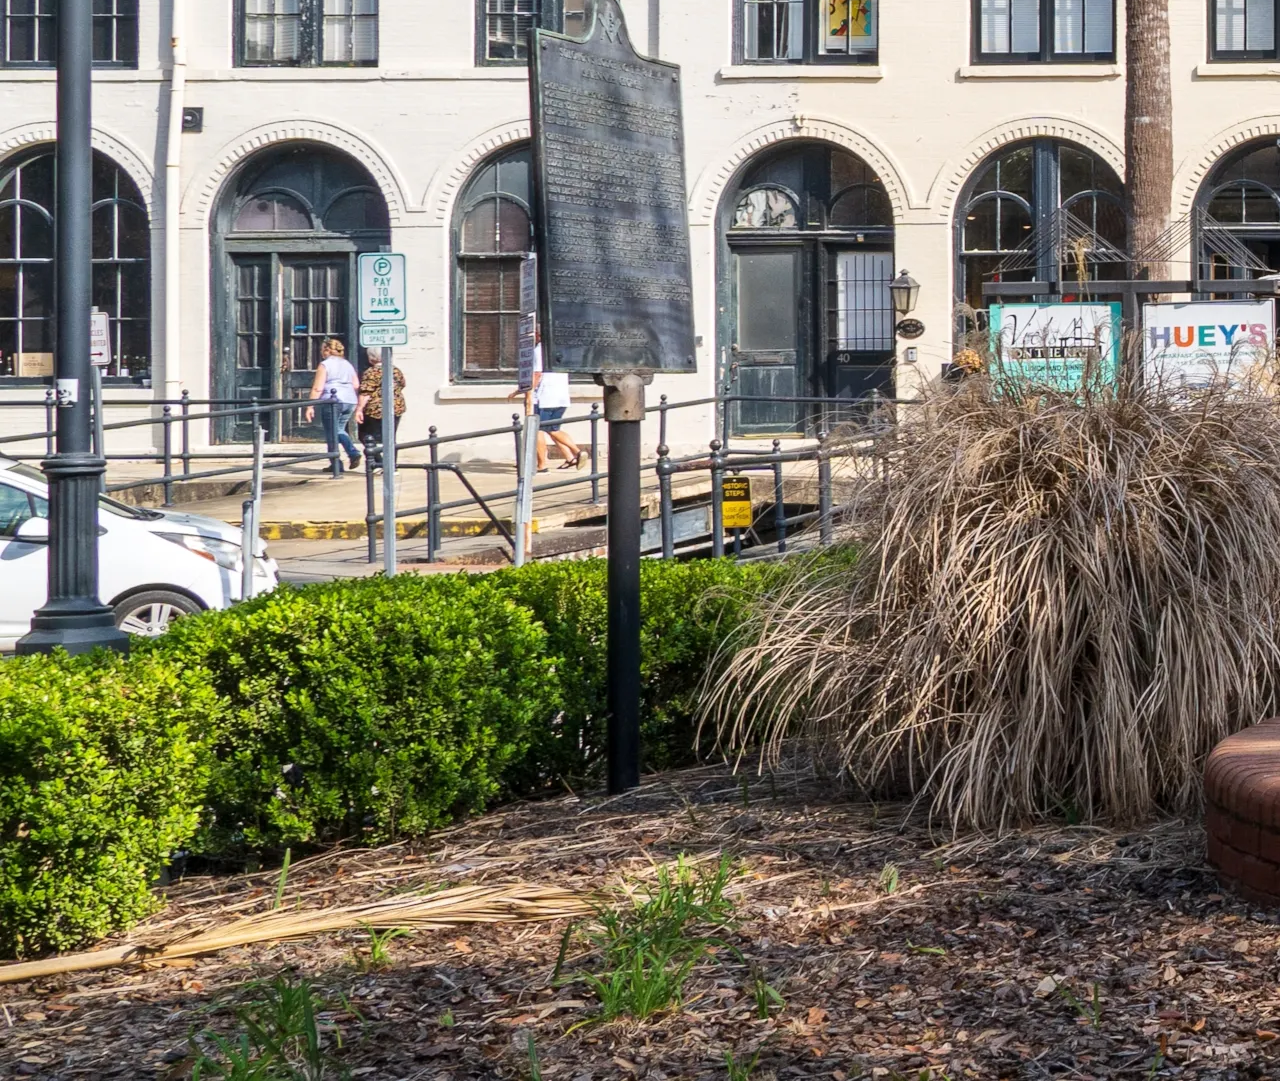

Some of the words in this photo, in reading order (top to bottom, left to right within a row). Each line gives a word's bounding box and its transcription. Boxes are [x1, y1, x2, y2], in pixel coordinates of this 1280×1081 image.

[373, 277, 391, 286] PAY
[377, 288, 388, 296] TO
[370, 298, 395, 306] PARK
[1149, 323, 1268, 348] HUEY'S
[836, 353, 850, 363] 40
